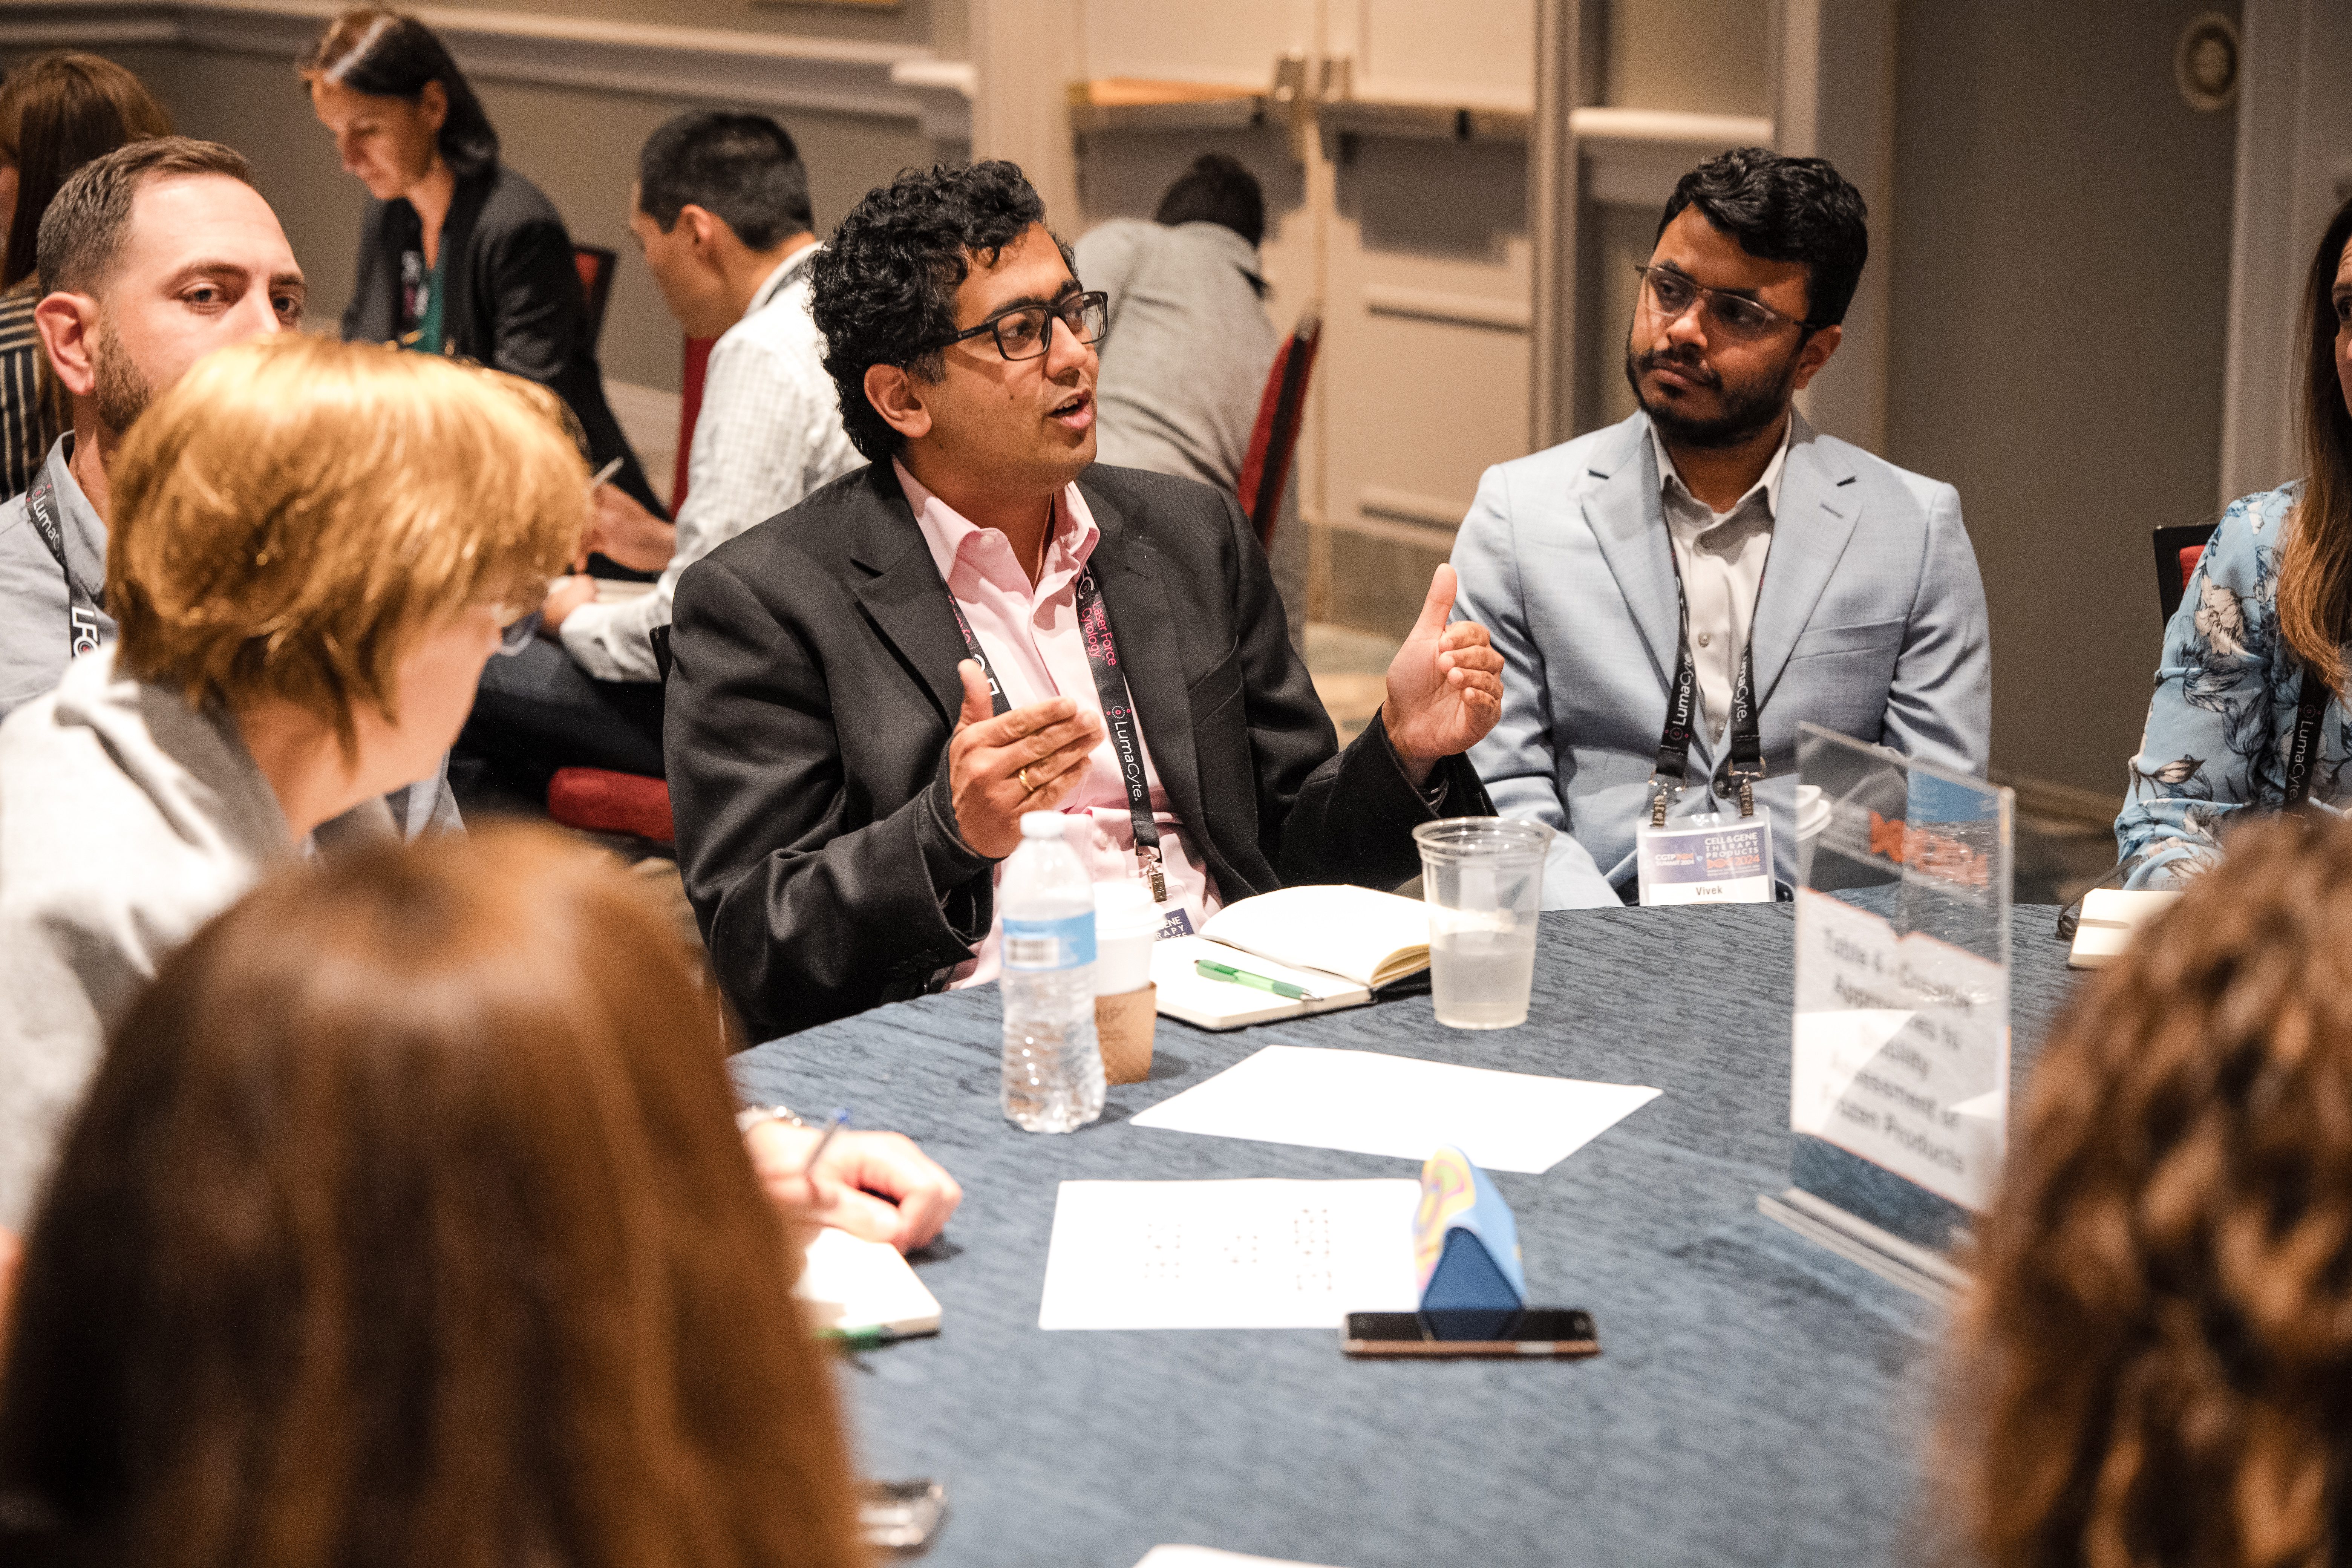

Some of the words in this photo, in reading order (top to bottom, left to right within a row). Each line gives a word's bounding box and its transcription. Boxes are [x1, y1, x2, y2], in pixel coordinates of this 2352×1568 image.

[1080, 607, 1101, 658] Cytology
[1092, 600, 1108, 631] Laser
[1101, 632, 1117, 666] Force
[1733, 831, 1758, 842] GENE
[1706, 840, 1758, 852] THERAPY
[1706, 847, 1759, 859] PRODUCTS
[1733, 853, 1760, 866] 2024
[1696, 885, 1723, 896] Vivek
